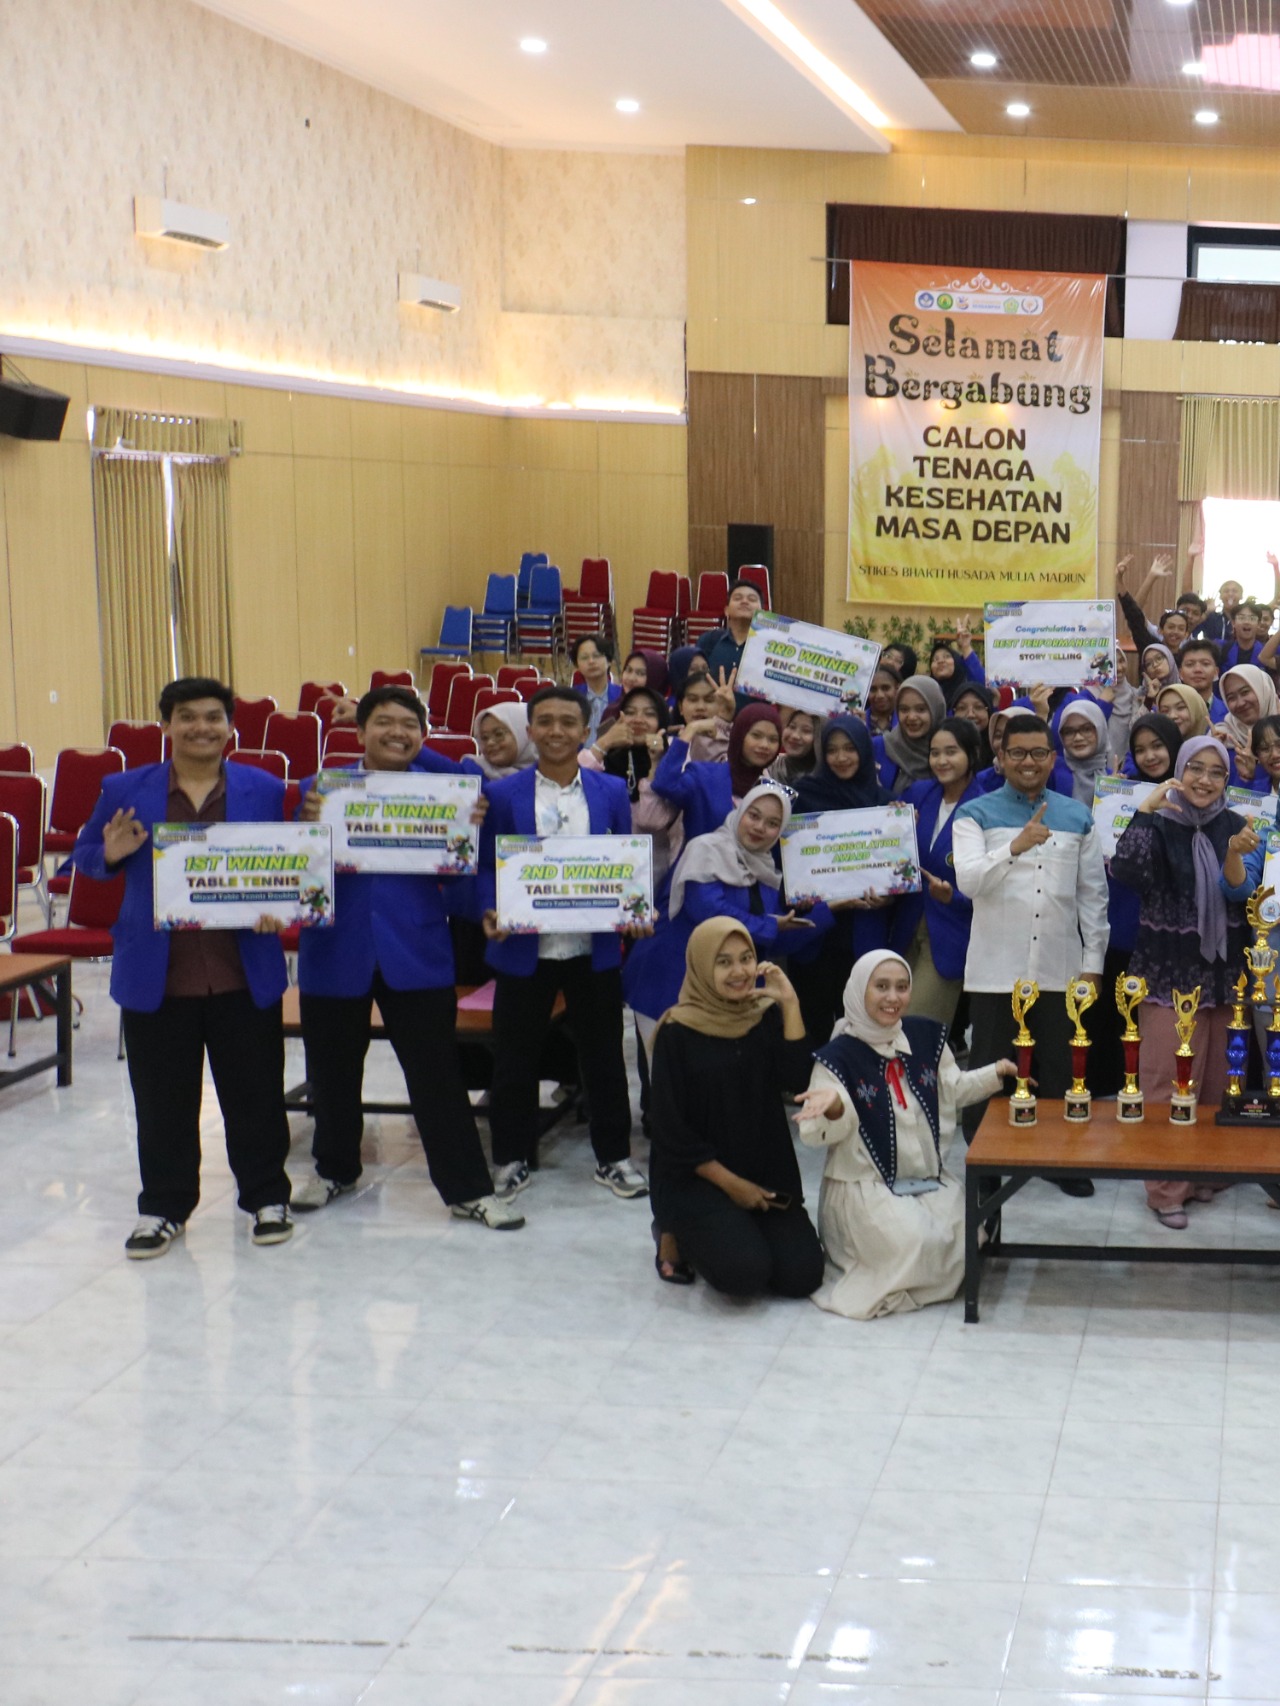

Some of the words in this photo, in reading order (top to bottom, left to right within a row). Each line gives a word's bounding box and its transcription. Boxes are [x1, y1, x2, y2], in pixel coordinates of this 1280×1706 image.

[889, 314, 1063, 362] Selamat
[865, 354, 1092, 414] Bergabung
[922, 425, 1026, 450] CALON
[913, 456, 1035, 482] TENAGA
[885, 485, 1062, 513] KESEHATAN
[875, 515, 962, 541] MASA
[971, 519, 1071, 544] DEPAN
[858, 565, 899, 578] STIKES
[902, 567, 945, 580] BHAKTI
[948, 568, 996, 582] HUSADA
[999, 570, 1036, 583] MULIA
[1039, 571, 1087, 584] MADIUN
[1015, 625, 1076, 634] Congratulation
[1078, 624, 1087, 632] To
[993, 638, 1020, 648] BEST
[1021, 638, 1097, 648] PERFORMANCE
[765, 640, 797, 658] 3RD
[798, 648, 859, 677] WINNER
[764, 657, 811, 676] PENCAK
[813, 670, 847, 686] SILAT
[344, 802, 379, 817] 1ST
[382, 803, 457, 820] WINNER
[346, 822, 392, 833] TABLE
[395, 823, 448, 834] TENNIS
[184, 855, 224, 872] 1ST
[226, 855, 309, 872] WINNER
[832, 851, 871, 863] AWARD
[518, 864, 558, 880] 2ND
[562, 864, 634, 880] WINNER
[811, 867, 836, 875] DANCE
[837, 862, 892, 873] PERFORMANCE
[186, 875, 239, 889] TABLE
[240, 875, 300, 888] TENNIS
[525, 884, 570, 895] TABLE
[572, 883, 624, 894] TENNIS
